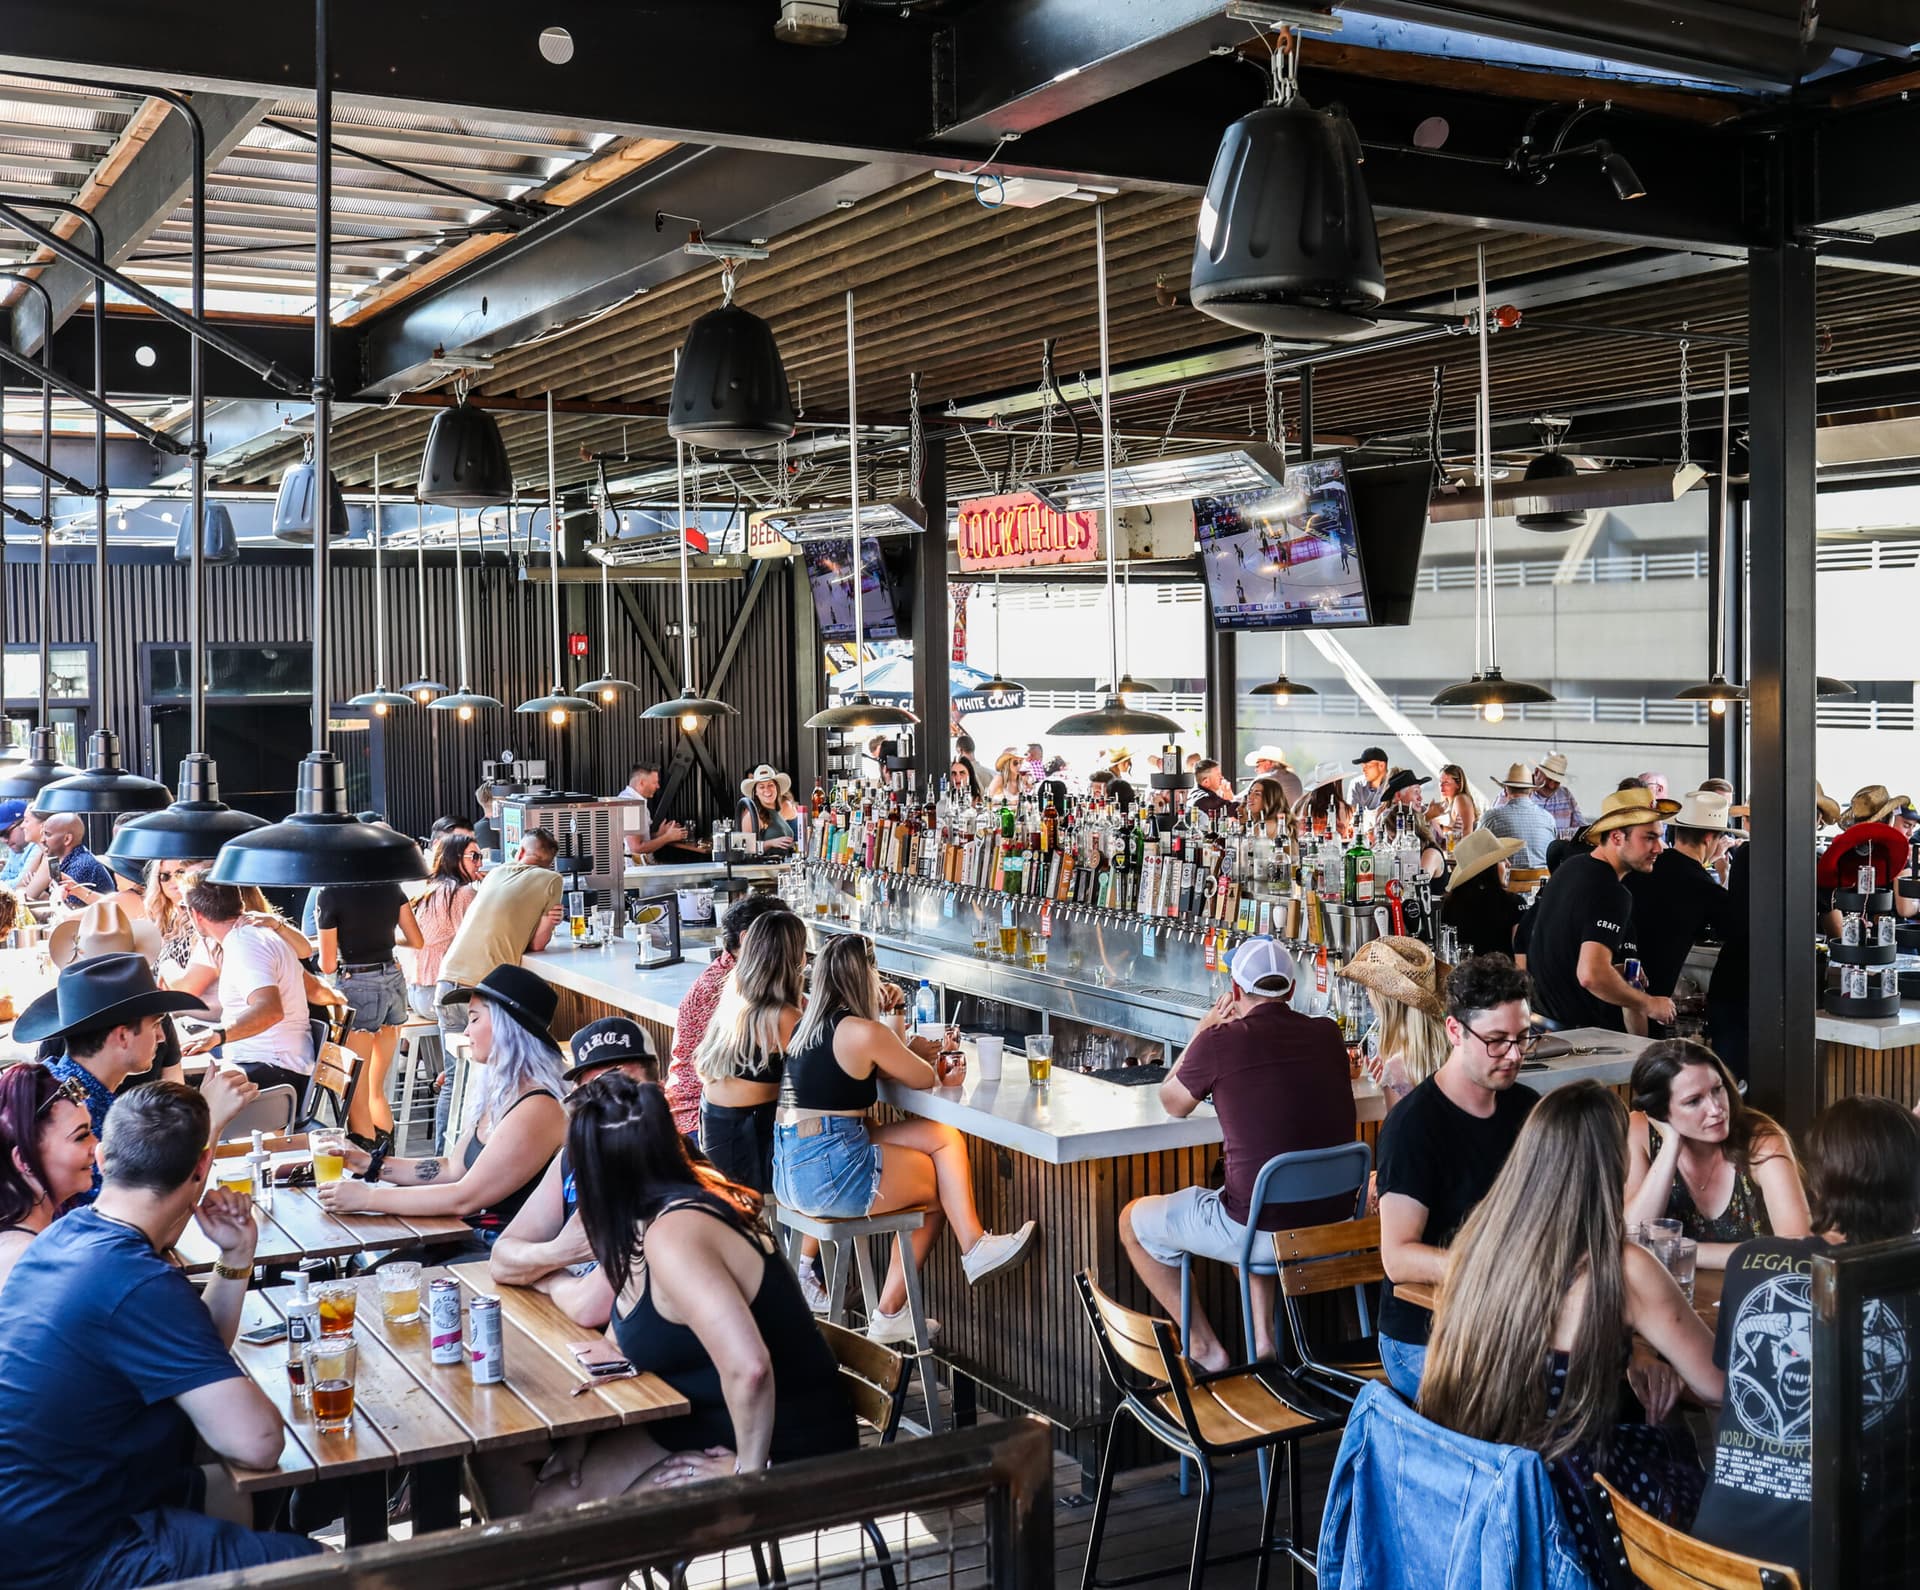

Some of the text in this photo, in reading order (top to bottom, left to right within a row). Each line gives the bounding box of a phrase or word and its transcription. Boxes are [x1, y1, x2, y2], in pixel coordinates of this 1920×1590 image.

[957, 503, 1089, 558] COCKTAILS
[955, 692, 1021, 711] WHITE CLAW
[1596, 920, 1621, 934] CRAFT
[578, 1031, 632, 1061] CIRCA
[1719, 1430, 1756, 1449] WORLD
[1760, 1436, 1805, 1459] TOUR
